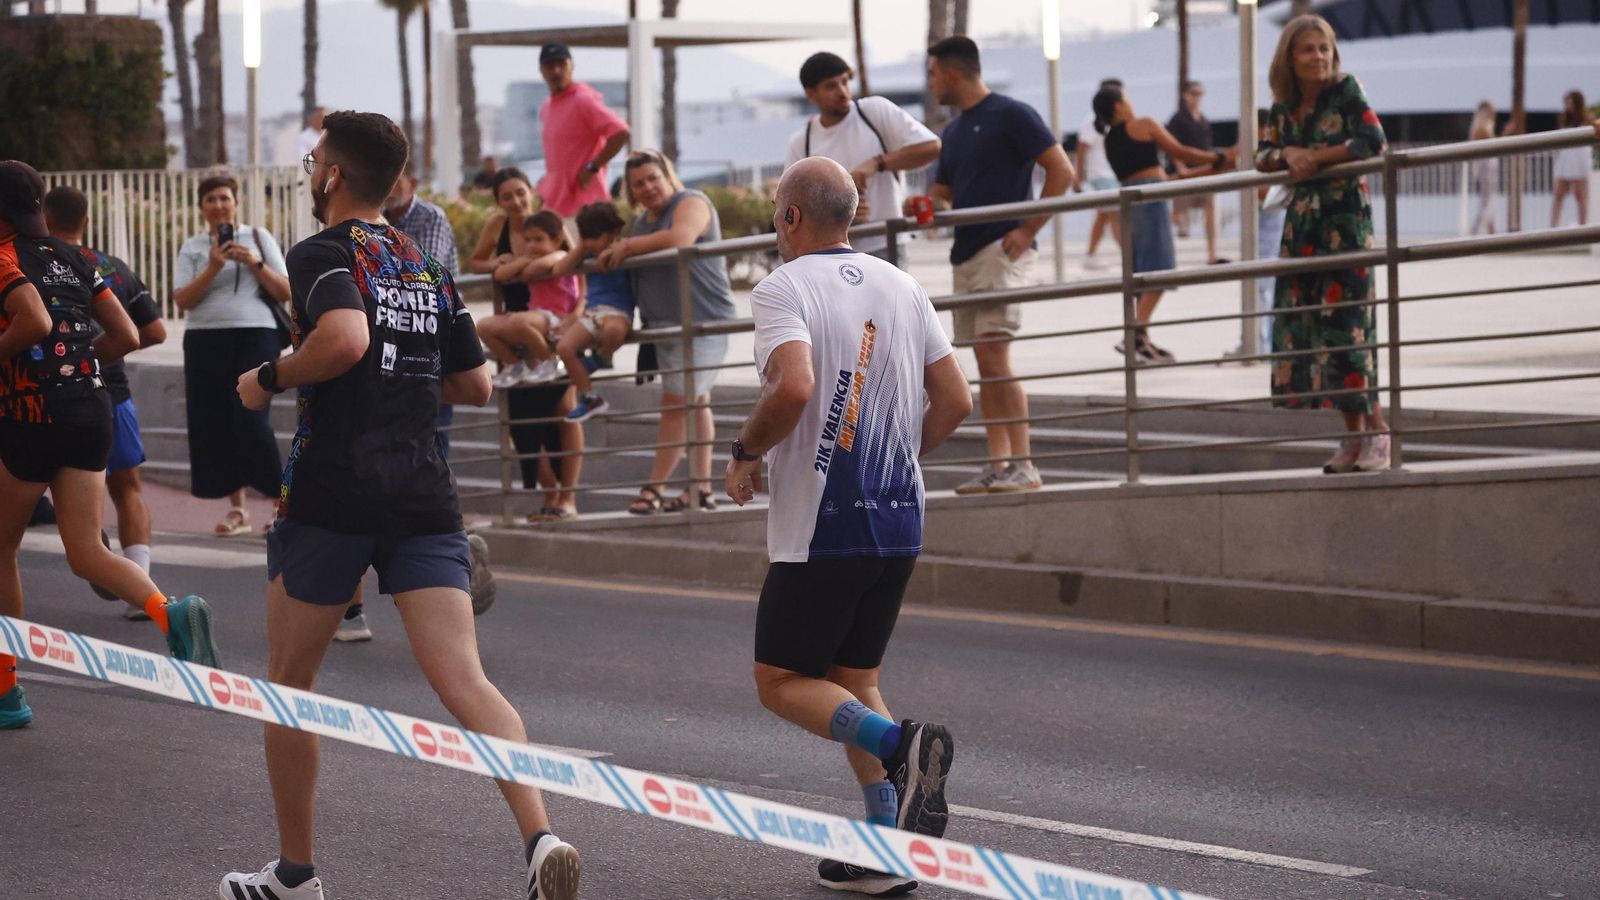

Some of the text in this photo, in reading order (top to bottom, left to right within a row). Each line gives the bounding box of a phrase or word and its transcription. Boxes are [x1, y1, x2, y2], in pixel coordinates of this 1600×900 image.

[376, 284, 438, 313] PONLE
[376, 305, 437, 334] FRENO
[814, 369, 852, 476] 21K VALENCIA
